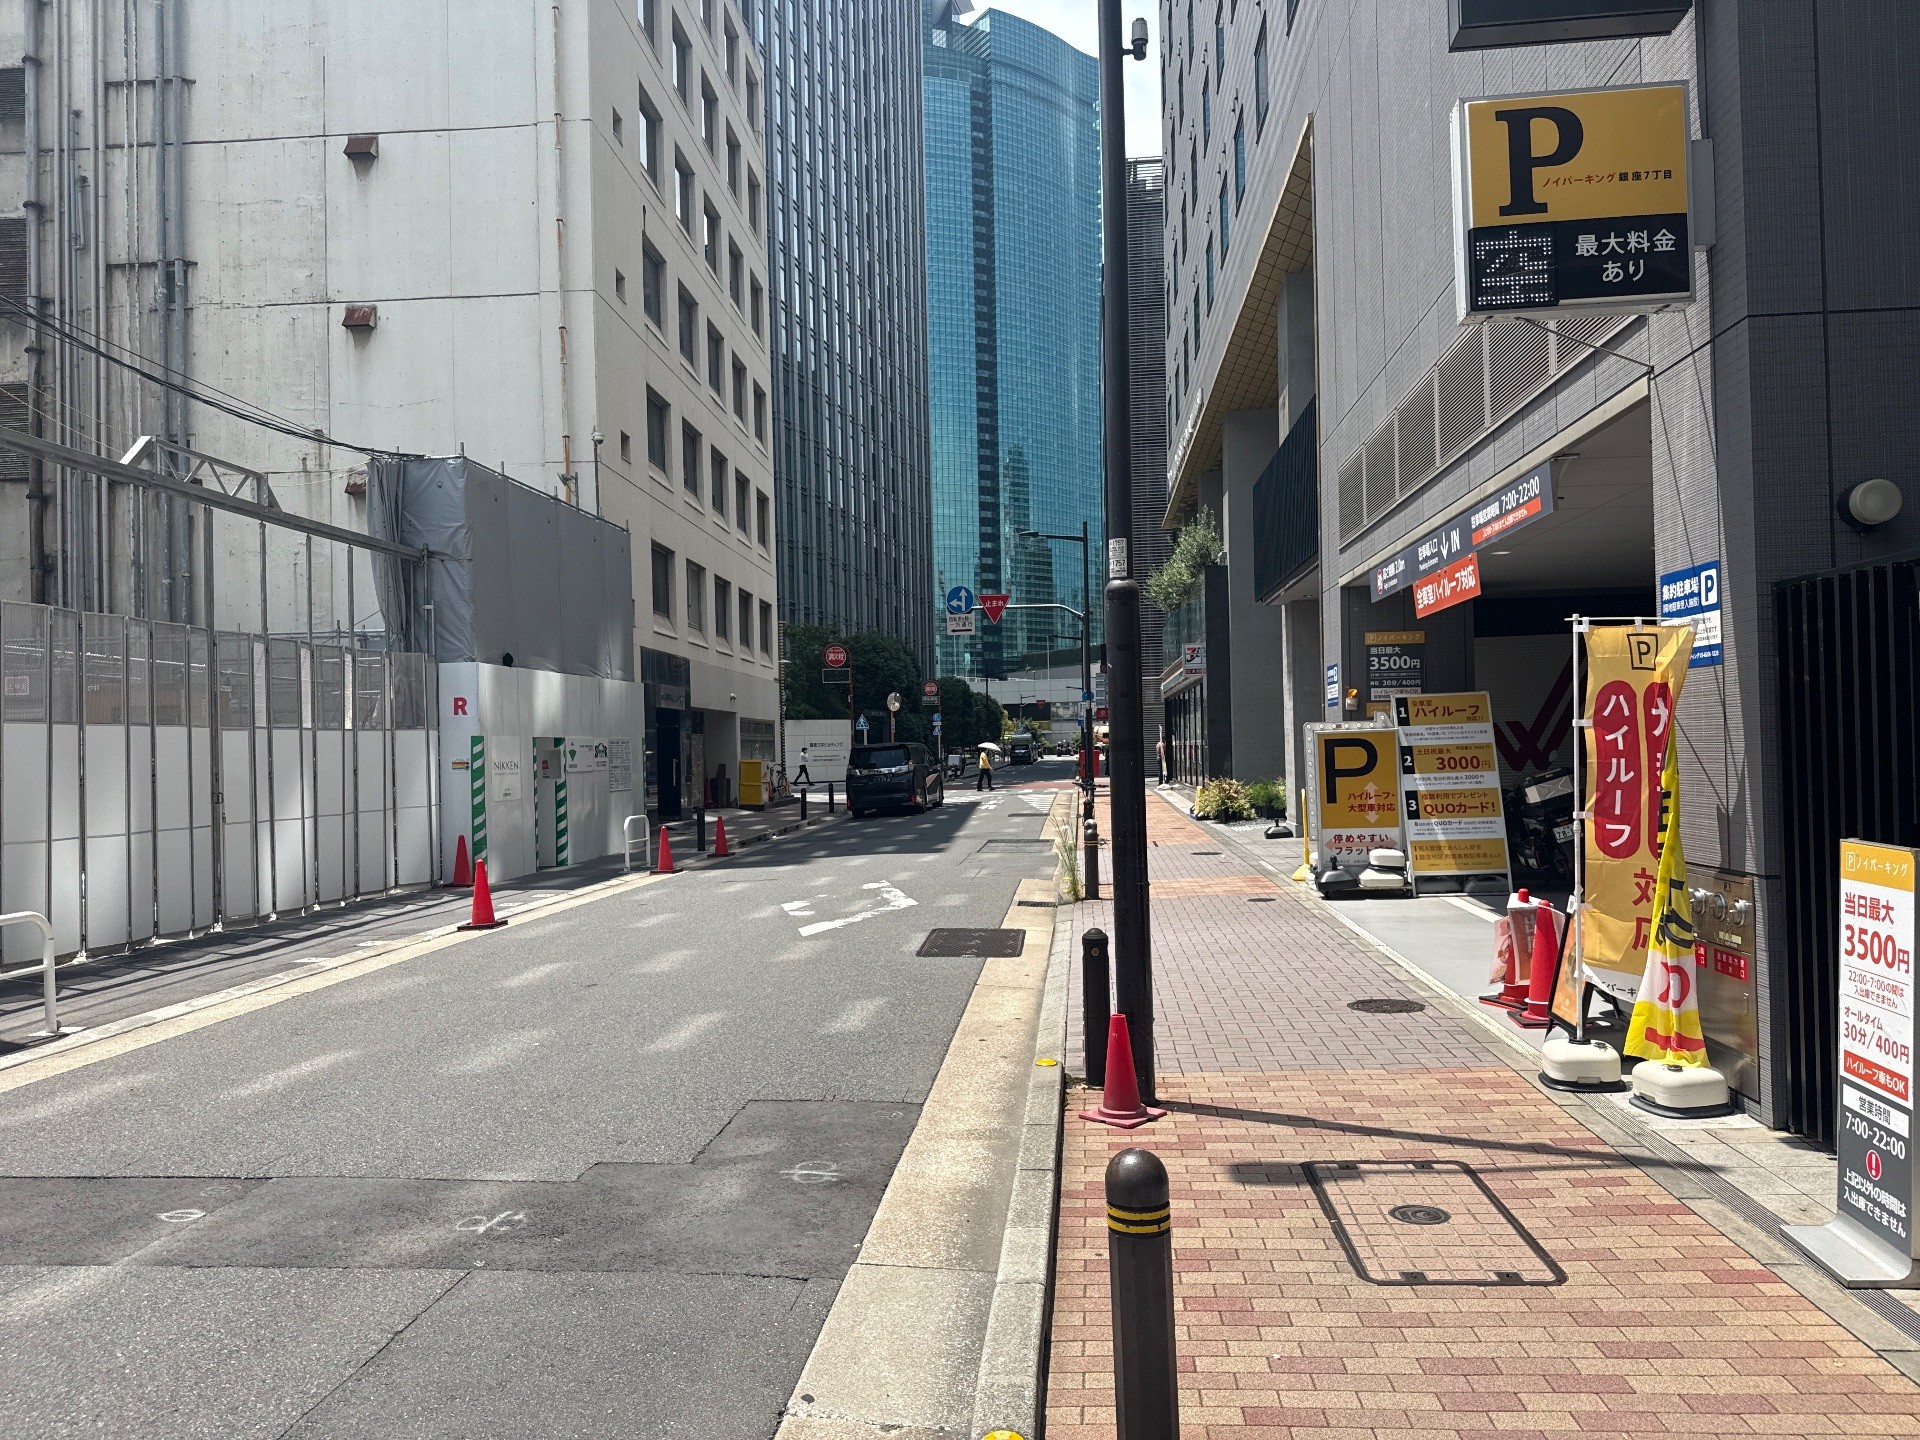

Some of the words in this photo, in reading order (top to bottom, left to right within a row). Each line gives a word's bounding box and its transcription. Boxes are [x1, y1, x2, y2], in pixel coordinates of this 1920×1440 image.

[1495, 106, 1584, 217] P
[1618, 169, 1673, 183] 銀座7丁目
[1575, 228, 1677, 257] 最大料金
[1602, 258, 1645, 283] あり
[1501, 475, 1540, 513] 7:00-22:00
[1450, 527, 1461, 554] IN
[1416, 565, 1476, 610] 全車室ハイルーフ対応
[1662, 576, 1700, 601] 集約駐車場
[1704, 574, 1715, 603] P
[985, 600, 1004, 608] 止まれ
[1369, 655, 1421, 670] 3500円
[1370, 646, 1402, 655] 当日最大
[1637, 639, 1651, 661] P
[453, 697, 469, 716] R
[1414, 704, 1480, 718] ハイルーフ
[1416, 747, 1452, 756] 土日祝最大
[1435, 755, 1491, 771] 3000円
[493, 760, 519, 771] NIKKEN
[1324, 738, 1378, 804] P
[1602, 693, 1635, 849] ハイルーフ
[1347, 803, 1396, 813] 大型車対応
[1408, 799, 1417, 811] 3
[1421, 792, 1489, 801] 複数利用でプレゼント
[1423, 801, 1496, 817] QUOカード!
[1333, 833, 1389, 844] 停めやすい
[1856, 853, 1909, 877] ノイパーキング
[1844, 891, 1895, 925] 当日最大
[1844, 923, 1910, 974] 3500円
[1848, 969, 1905, 998] 22:00-7:00の間は
[1853, 984, 1899, 1009] 入出庫できません
[1844, 1005, 1884, 1031] オールタイム
[1846, 1055, 1906, 1095] ハイルーフ車もOK
[1858, 1094, 1891, 1126] 営業時間
[1845, 1112, 1906, 1160] 7:00-22:00
[1843, 1167, 1907, 1219] 上記以外の時間は
[1843, 1186, 1907, 1239] 入出庫できません
